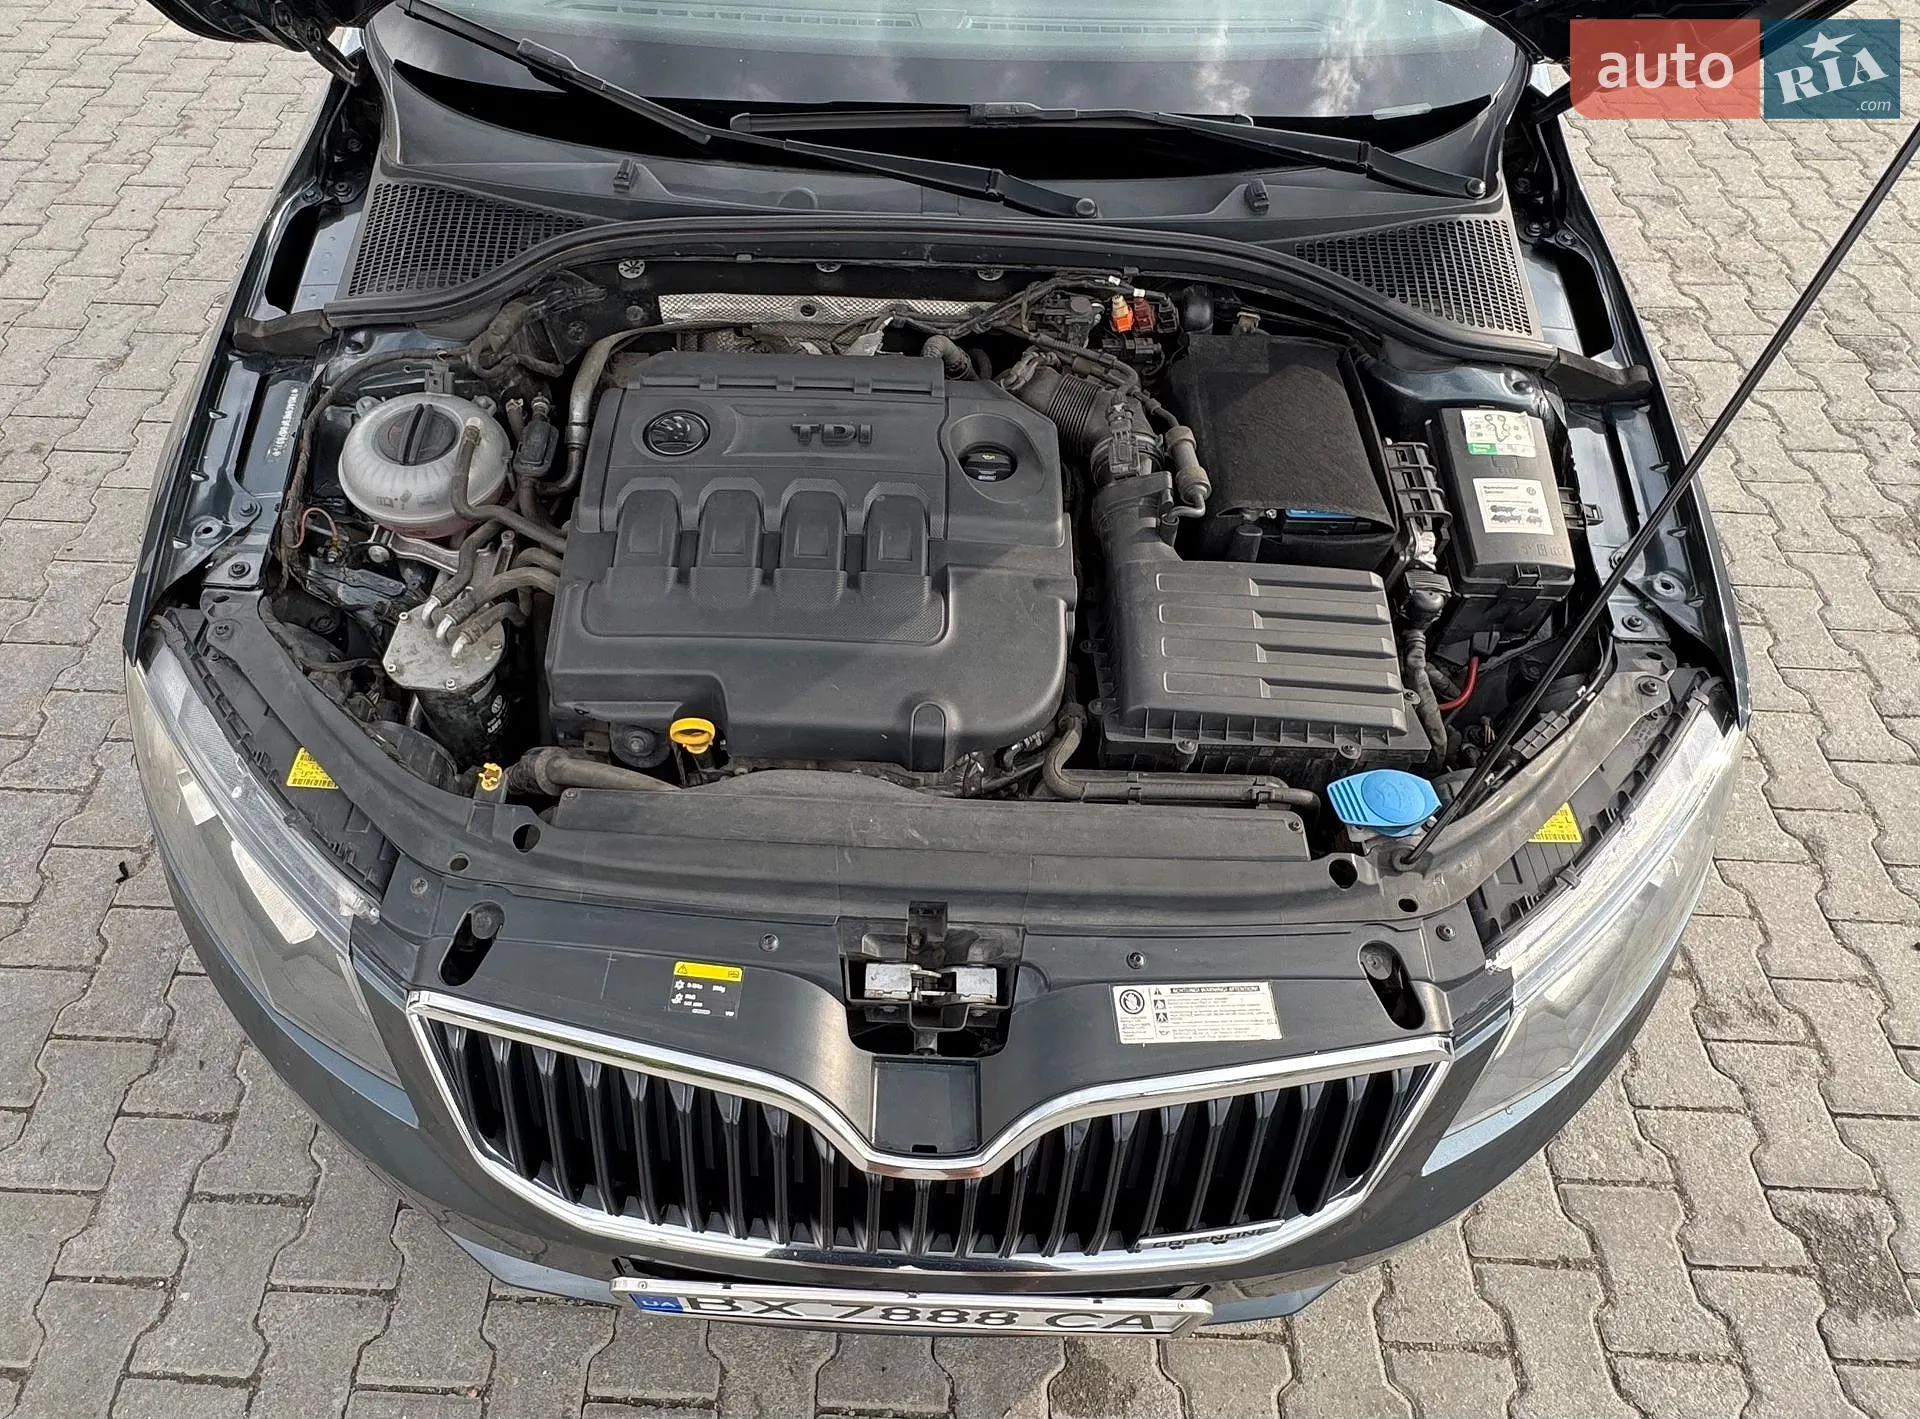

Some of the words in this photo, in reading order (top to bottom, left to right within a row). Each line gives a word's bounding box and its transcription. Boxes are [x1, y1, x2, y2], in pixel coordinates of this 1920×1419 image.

[791, 423, 873, 446] TDI
[642, 1300, 677, 1308] UA
[687, 1297, 803, 1317] BX
[830, 1304, 1016, 1326] 7888
[1046, 1312, 1154, 1330] CA
